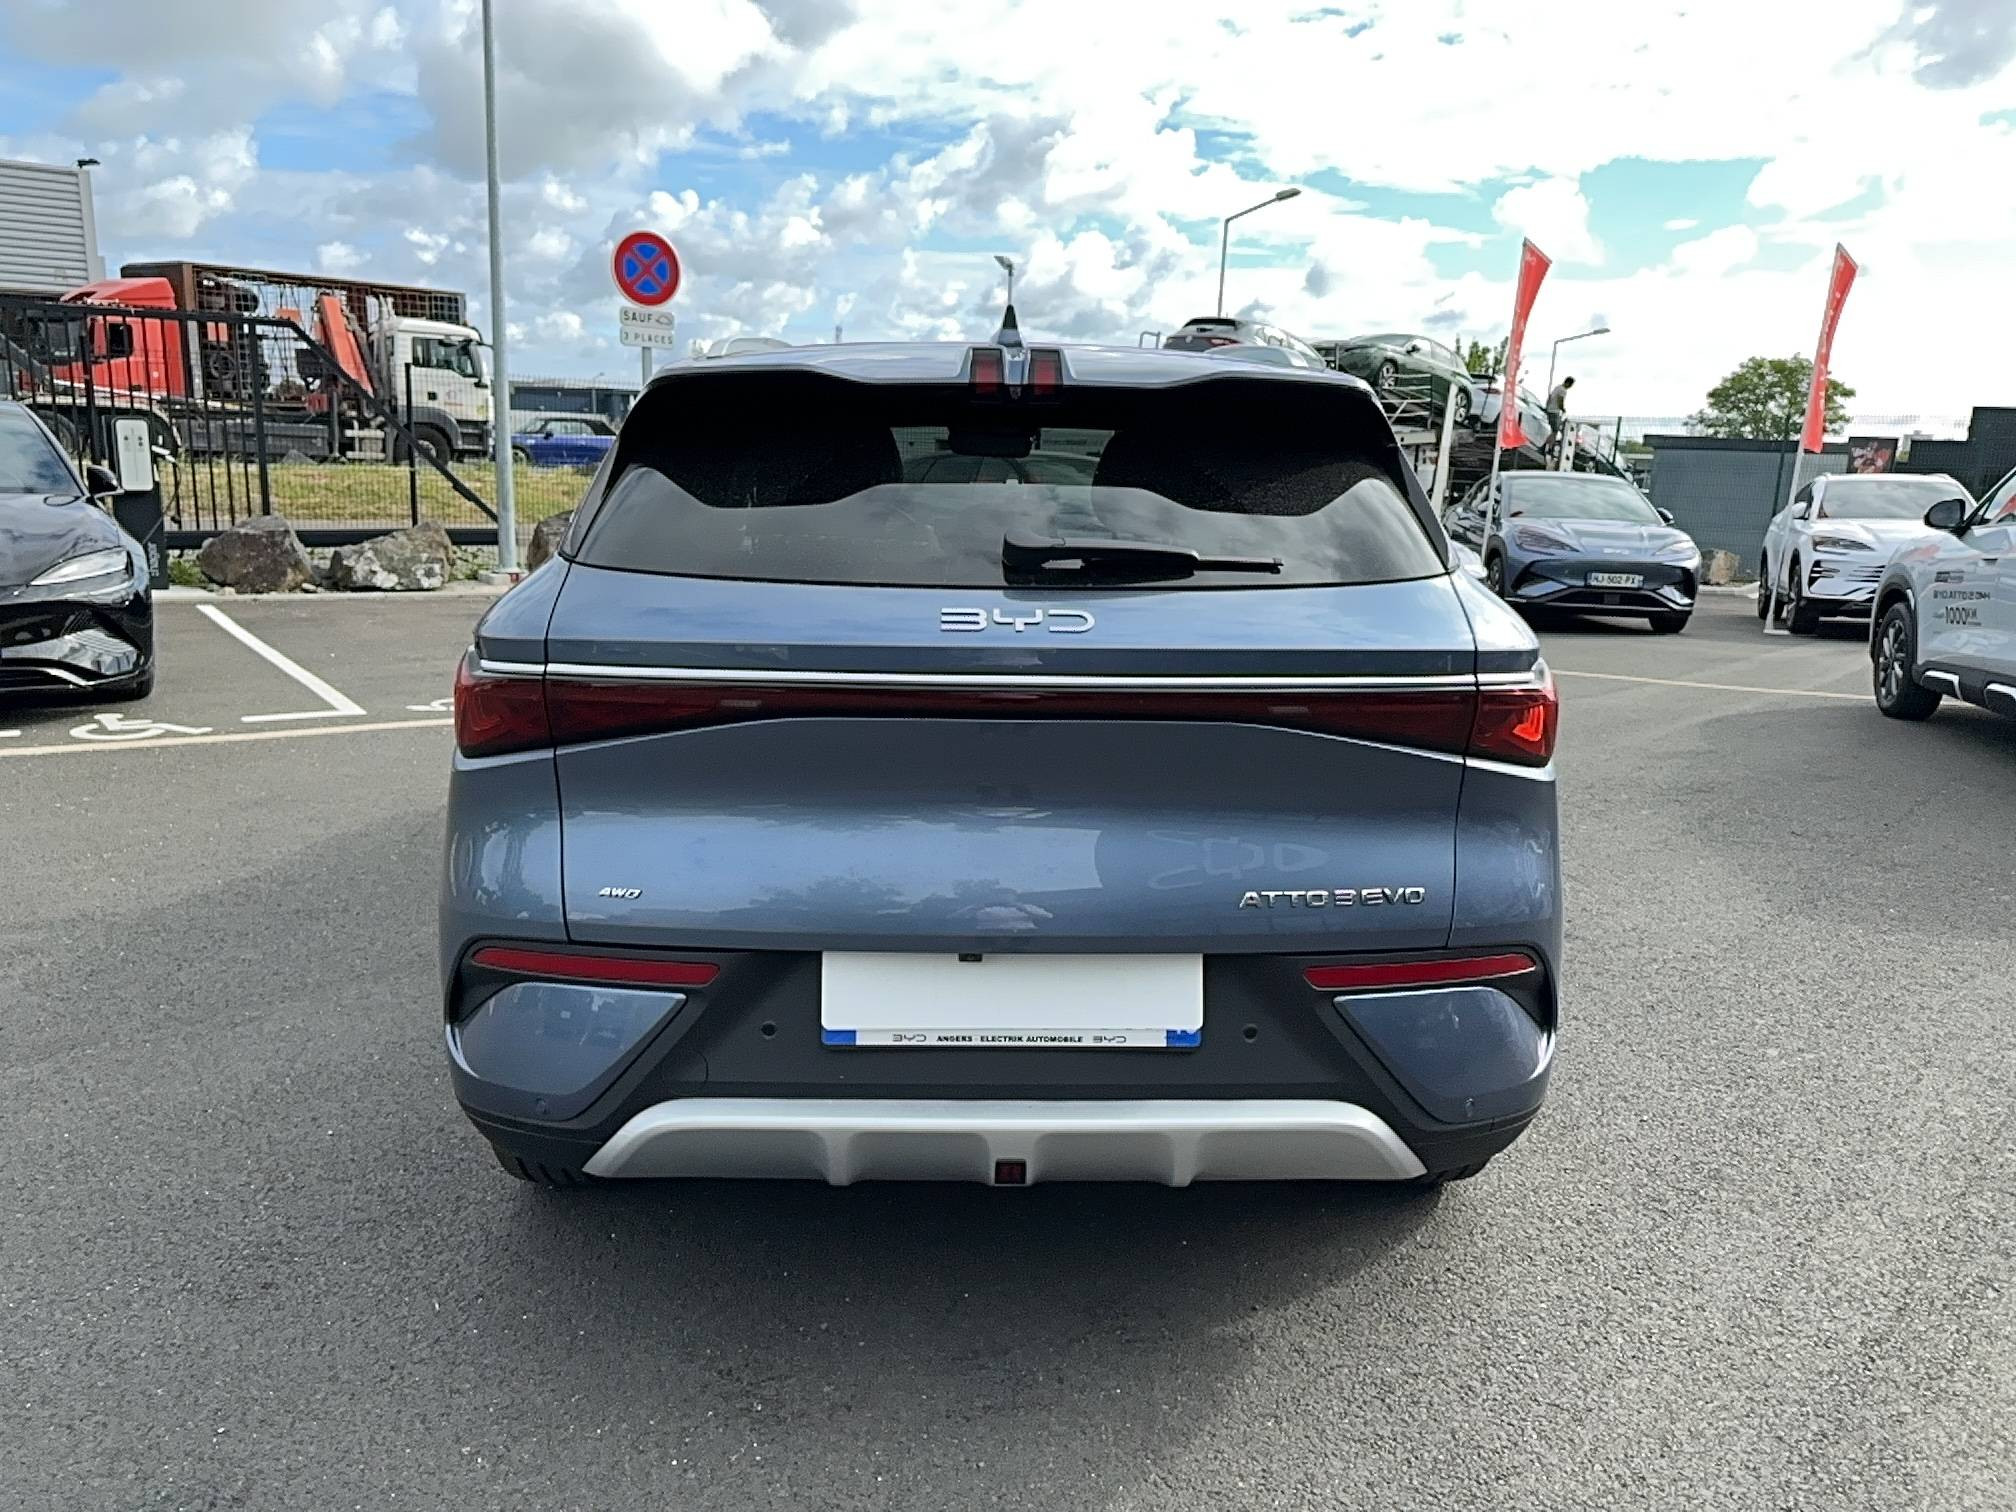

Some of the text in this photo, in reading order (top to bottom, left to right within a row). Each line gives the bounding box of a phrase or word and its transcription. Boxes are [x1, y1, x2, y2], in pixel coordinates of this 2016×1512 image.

[623, 310, 653, 323] SAUF
[633, 332, 673, 345] PLACES
[940, 607, 1096, 634] BYD
[1239, 890, 1329, 910] ATTO
[1361, 887, 1426, 906] EVO
[892, 1033, 1127, 1044] BYD ANGERS ELECTRIK AUTOMOBILE BYD
